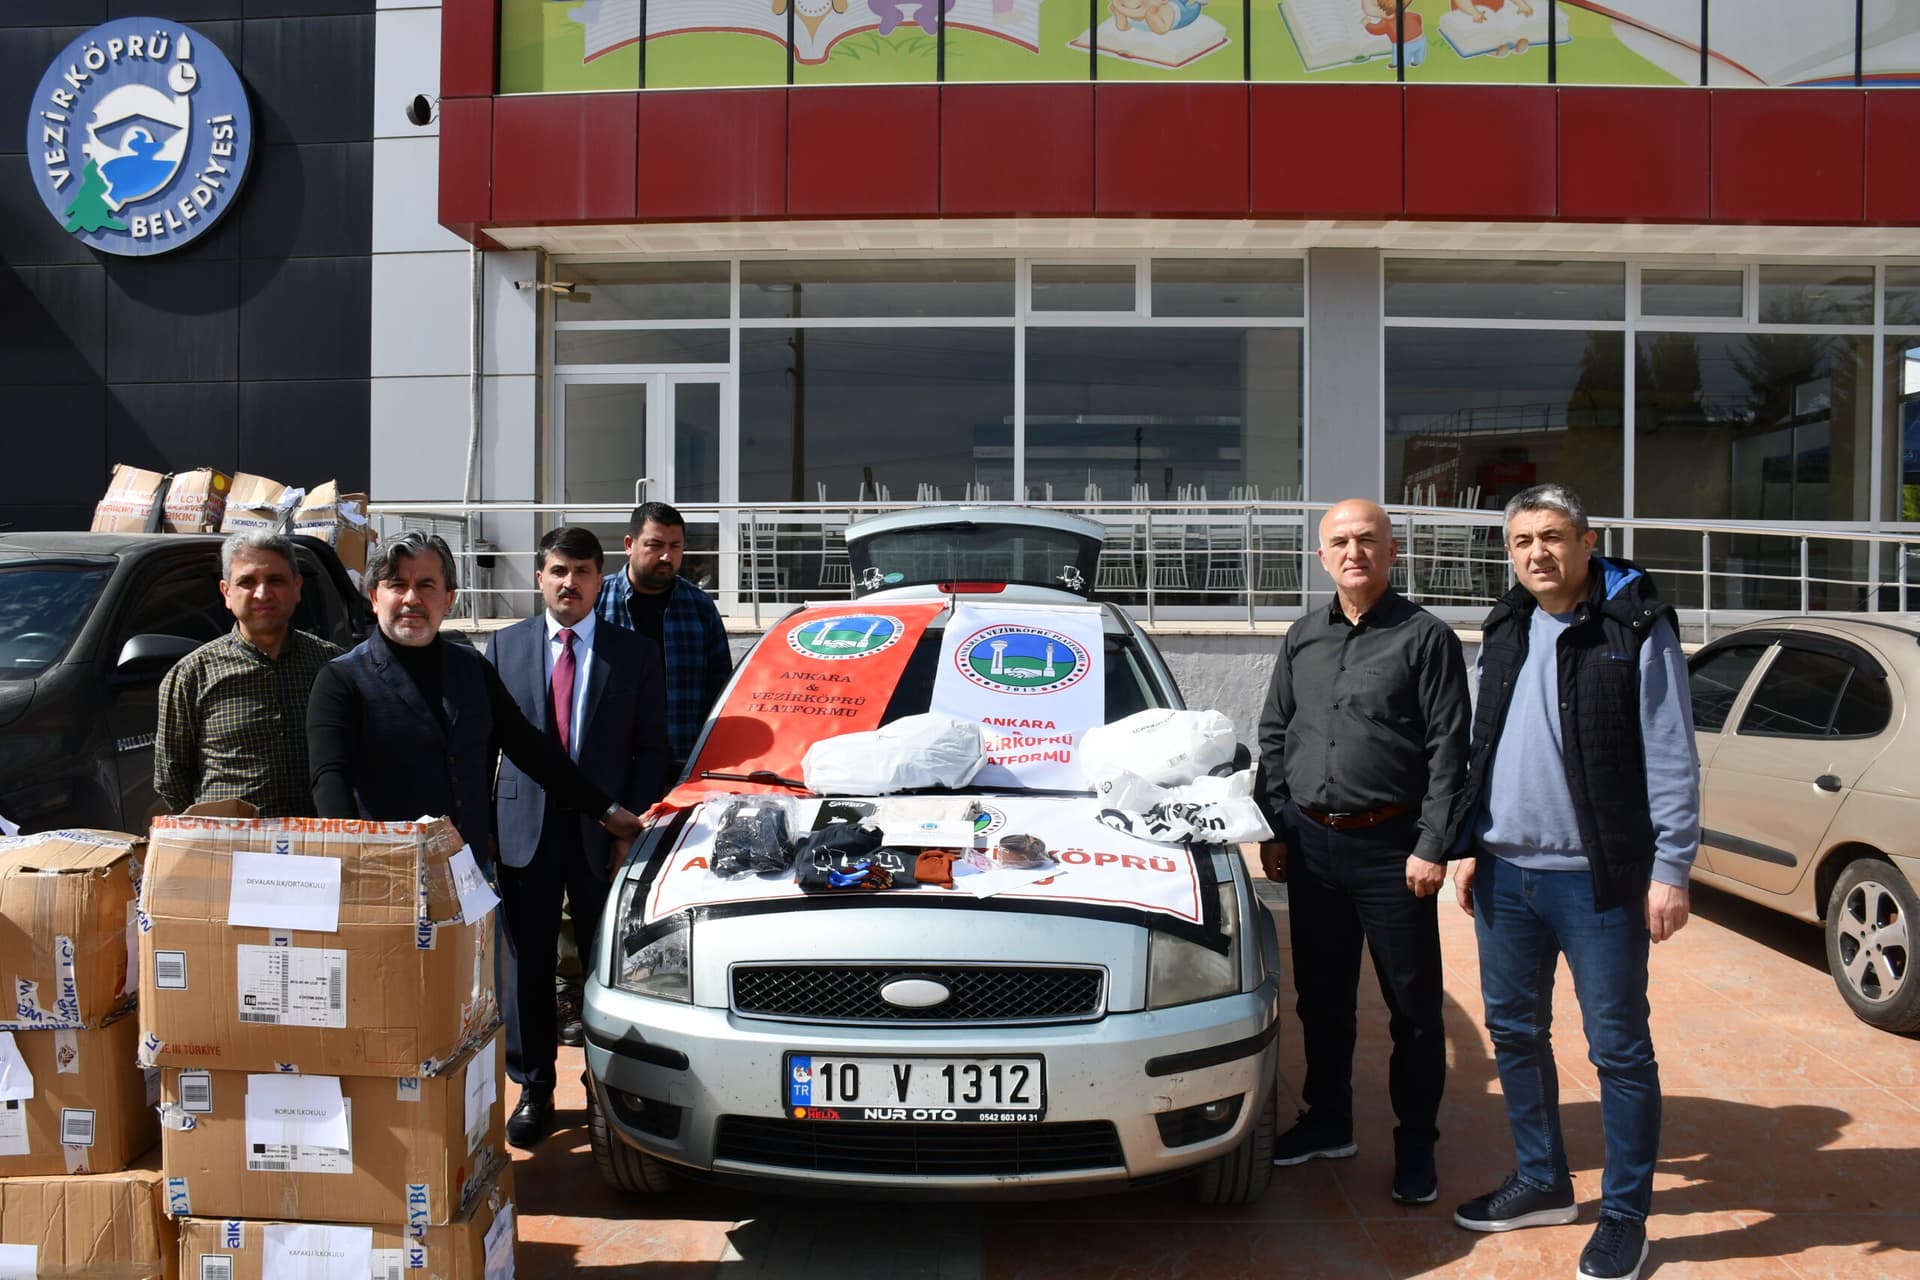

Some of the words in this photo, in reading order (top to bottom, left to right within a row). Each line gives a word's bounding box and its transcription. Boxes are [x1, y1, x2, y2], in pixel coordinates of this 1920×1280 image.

[40, 30, 169, 190] VEZİRKÖPRÜ
[131, 113, 235, 238] BELEDİYESİ
[779, 671, 852, 683] ANKARA
[751, 691, 867, 706] VEZİRKÖPRÜ
[745, 703, 860, 718] PLATFORMU
[981, 717, 1057, 730] ANKARA
[986, 750, 1071, 766] ATFORMU
[184, 1042, 222, 1056] TÜRKİYE
[793, 1085, 809, 1096] TR
[819, 1063, 859, 1101] 10
[892, 1064, 912, 1103] V
[941, 1064, 1030, 1104] 1312
[864, 1108, 907, 1120] NUR
[912, 1109, 957, 1121] OTO
[979, 1113, 999, 1121] 0542
[1016, 1113, 1027, 1122] 04
